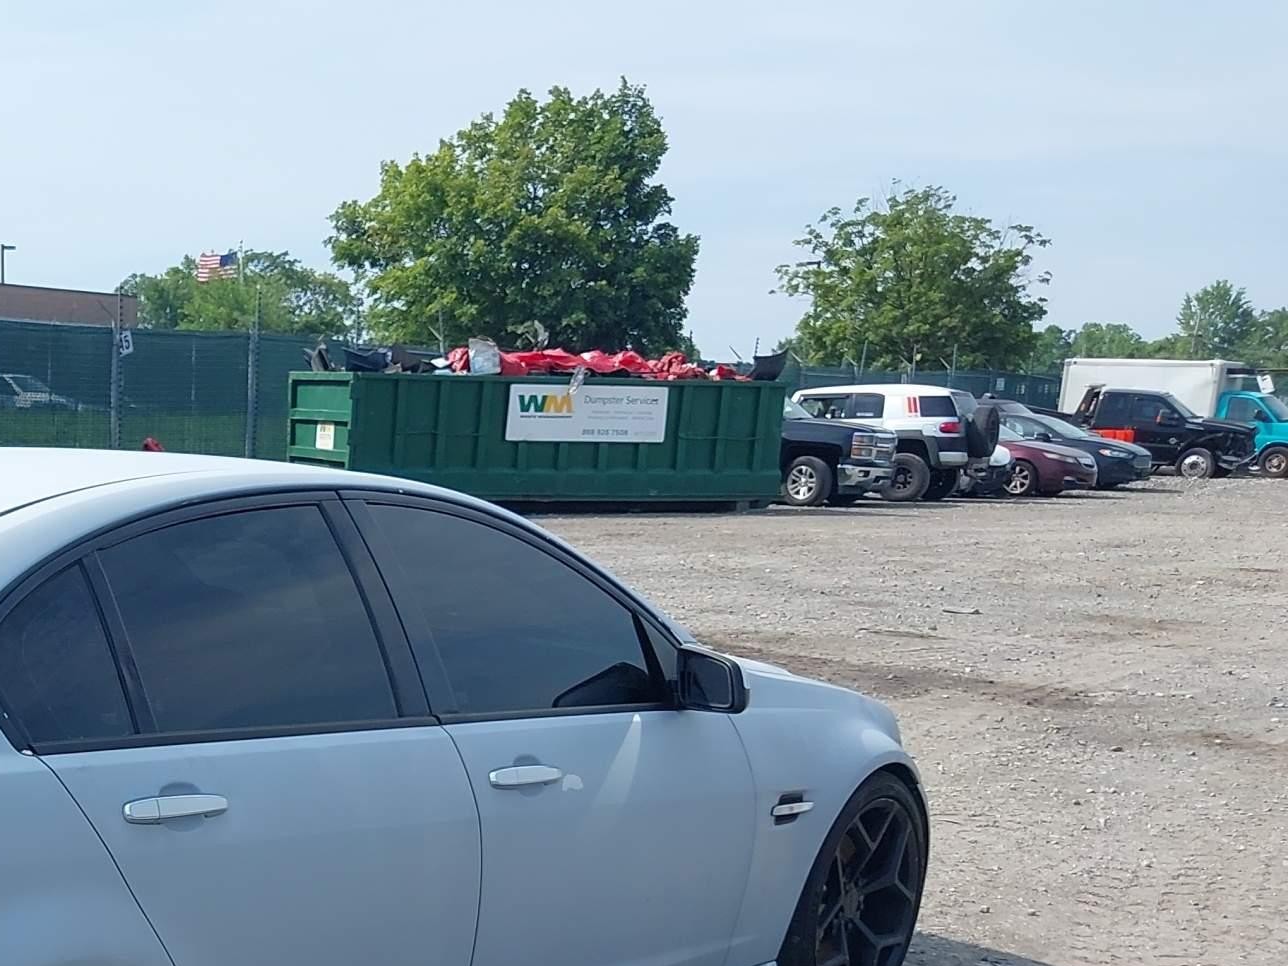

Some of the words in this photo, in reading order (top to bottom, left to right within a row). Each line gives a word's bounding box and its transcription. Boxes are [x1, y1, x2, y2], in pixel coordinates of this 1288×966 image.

[518, 394, 573, 413] WM
[583, 394, 624, 406] Dumpster
[625, 395, 659, 405] Services
